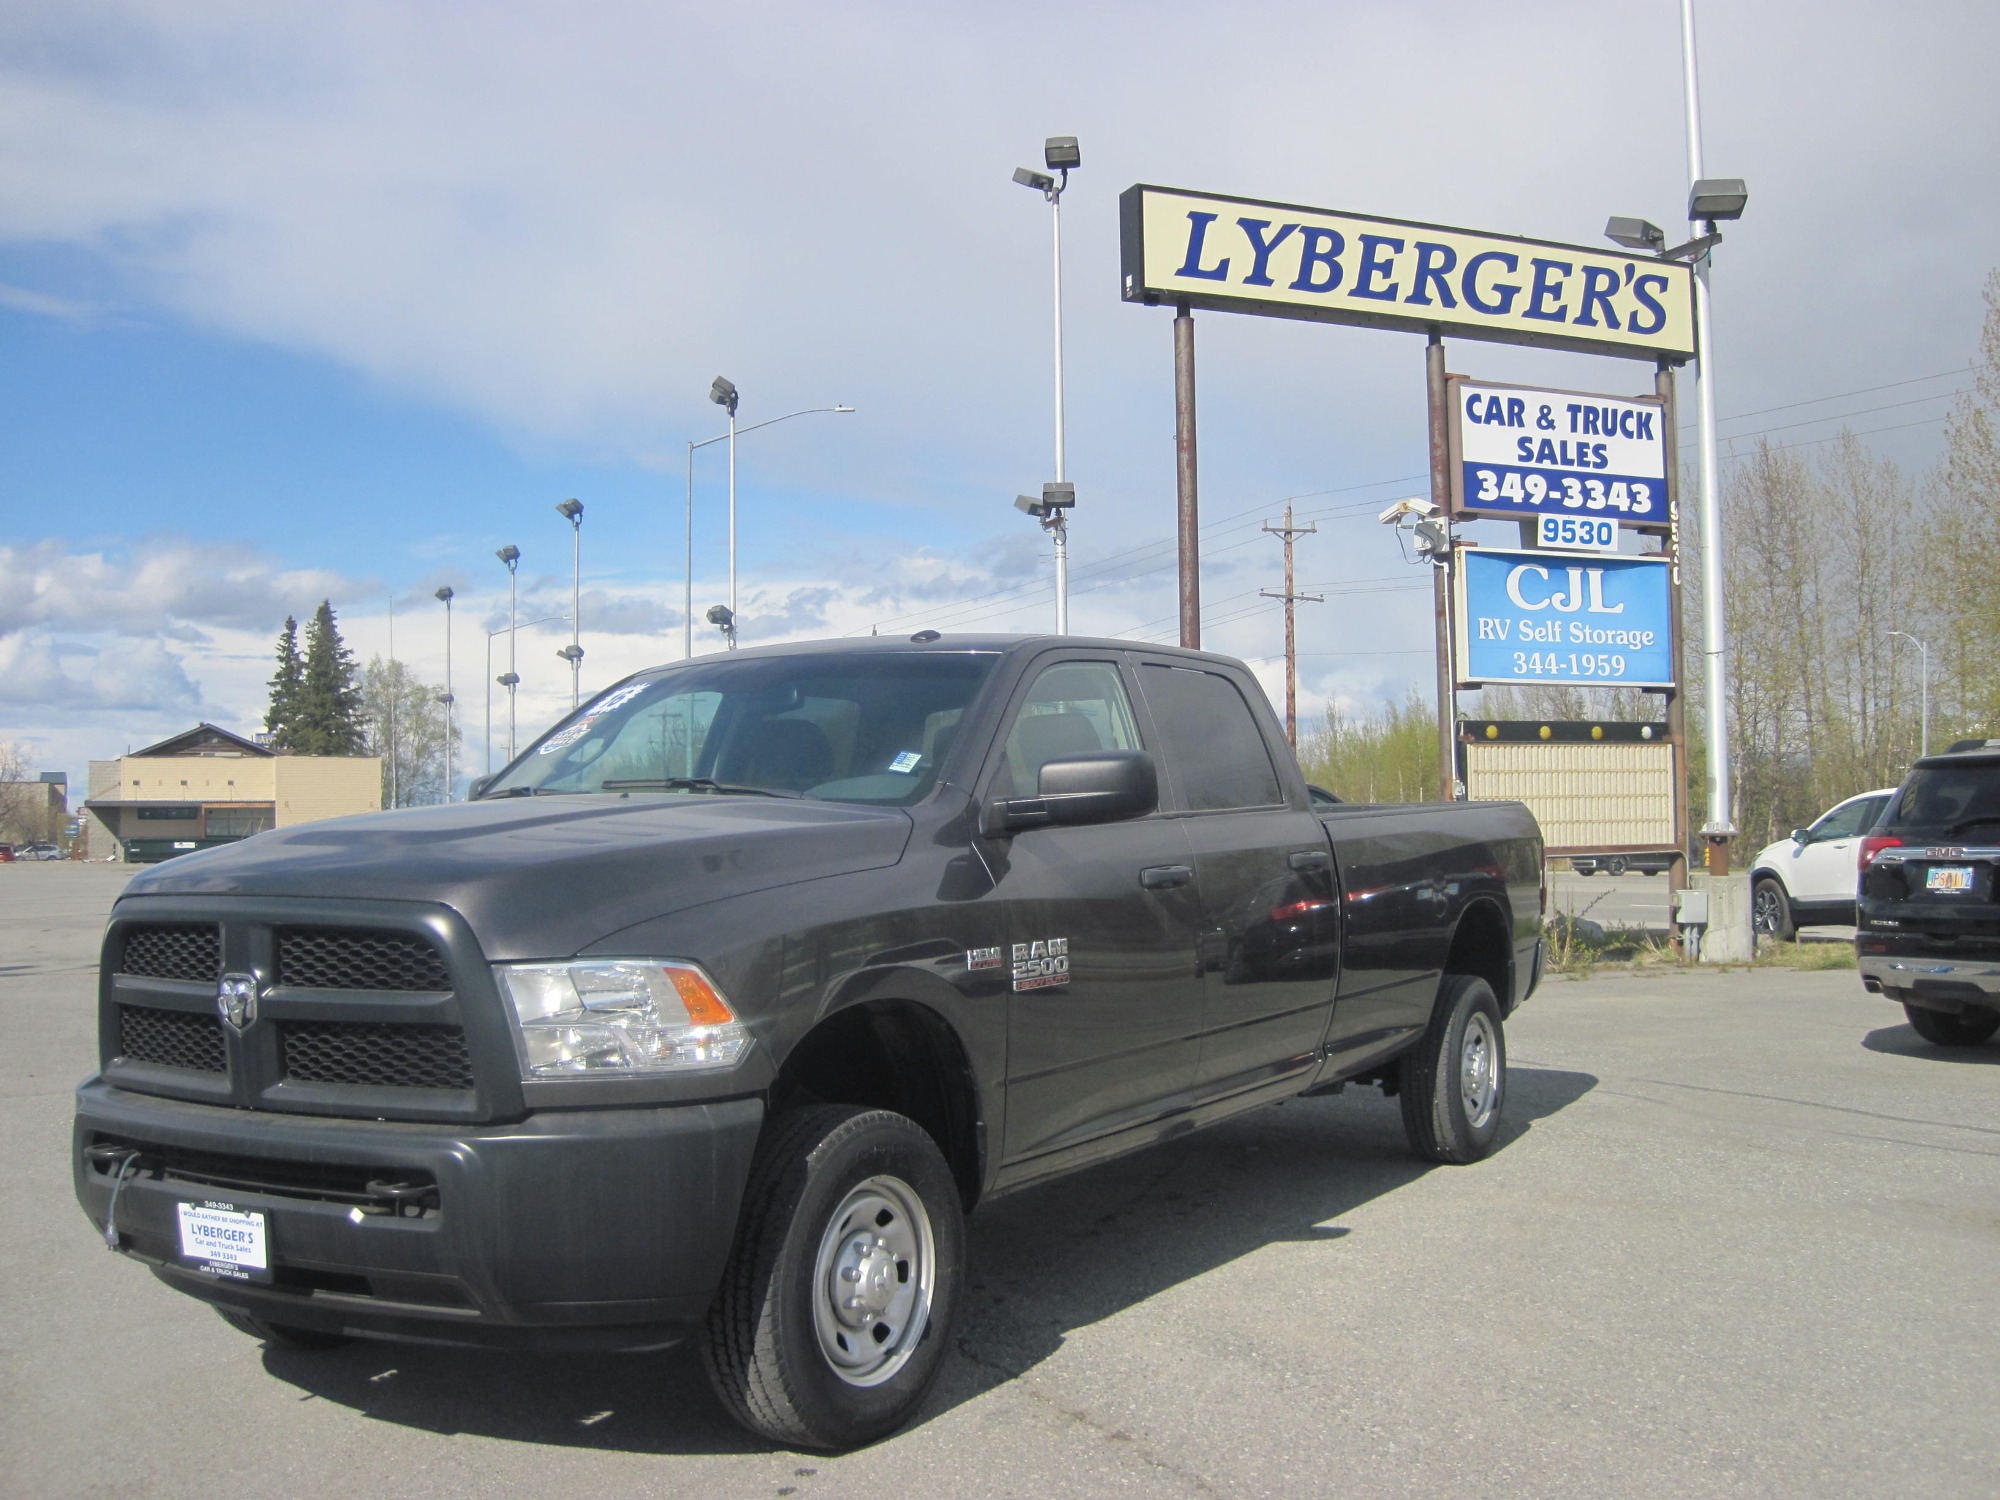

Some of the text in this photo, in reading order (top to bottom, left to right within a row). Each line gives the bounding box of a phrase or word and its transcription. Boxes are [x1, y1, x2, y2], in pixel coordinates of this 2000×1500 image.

[1174, 210, 1669, 335] LYBERGER'S
[1466, 393, 1654, 441] CAR & TRUCK
[1517, 436, 1609, 470] SALES
[1476, 469, 1652, 514] 349-3343
[1543, 518, 1613, 546] 9530
[1506, 563, 1625, 614] CJL
[1478, 617, 1655, 651] RV Self Storage
[1513, 652, 1627, 677] 344-1959
[1926, 846, 1965, 858] GMC
[1012, 938, 1069, 961] RAM
[1012, 955, 1069, 980] 2500
[204, 1200, 234, 1211] 349-3343
[191, 1223, 254, 1244] LYBERGER'S
